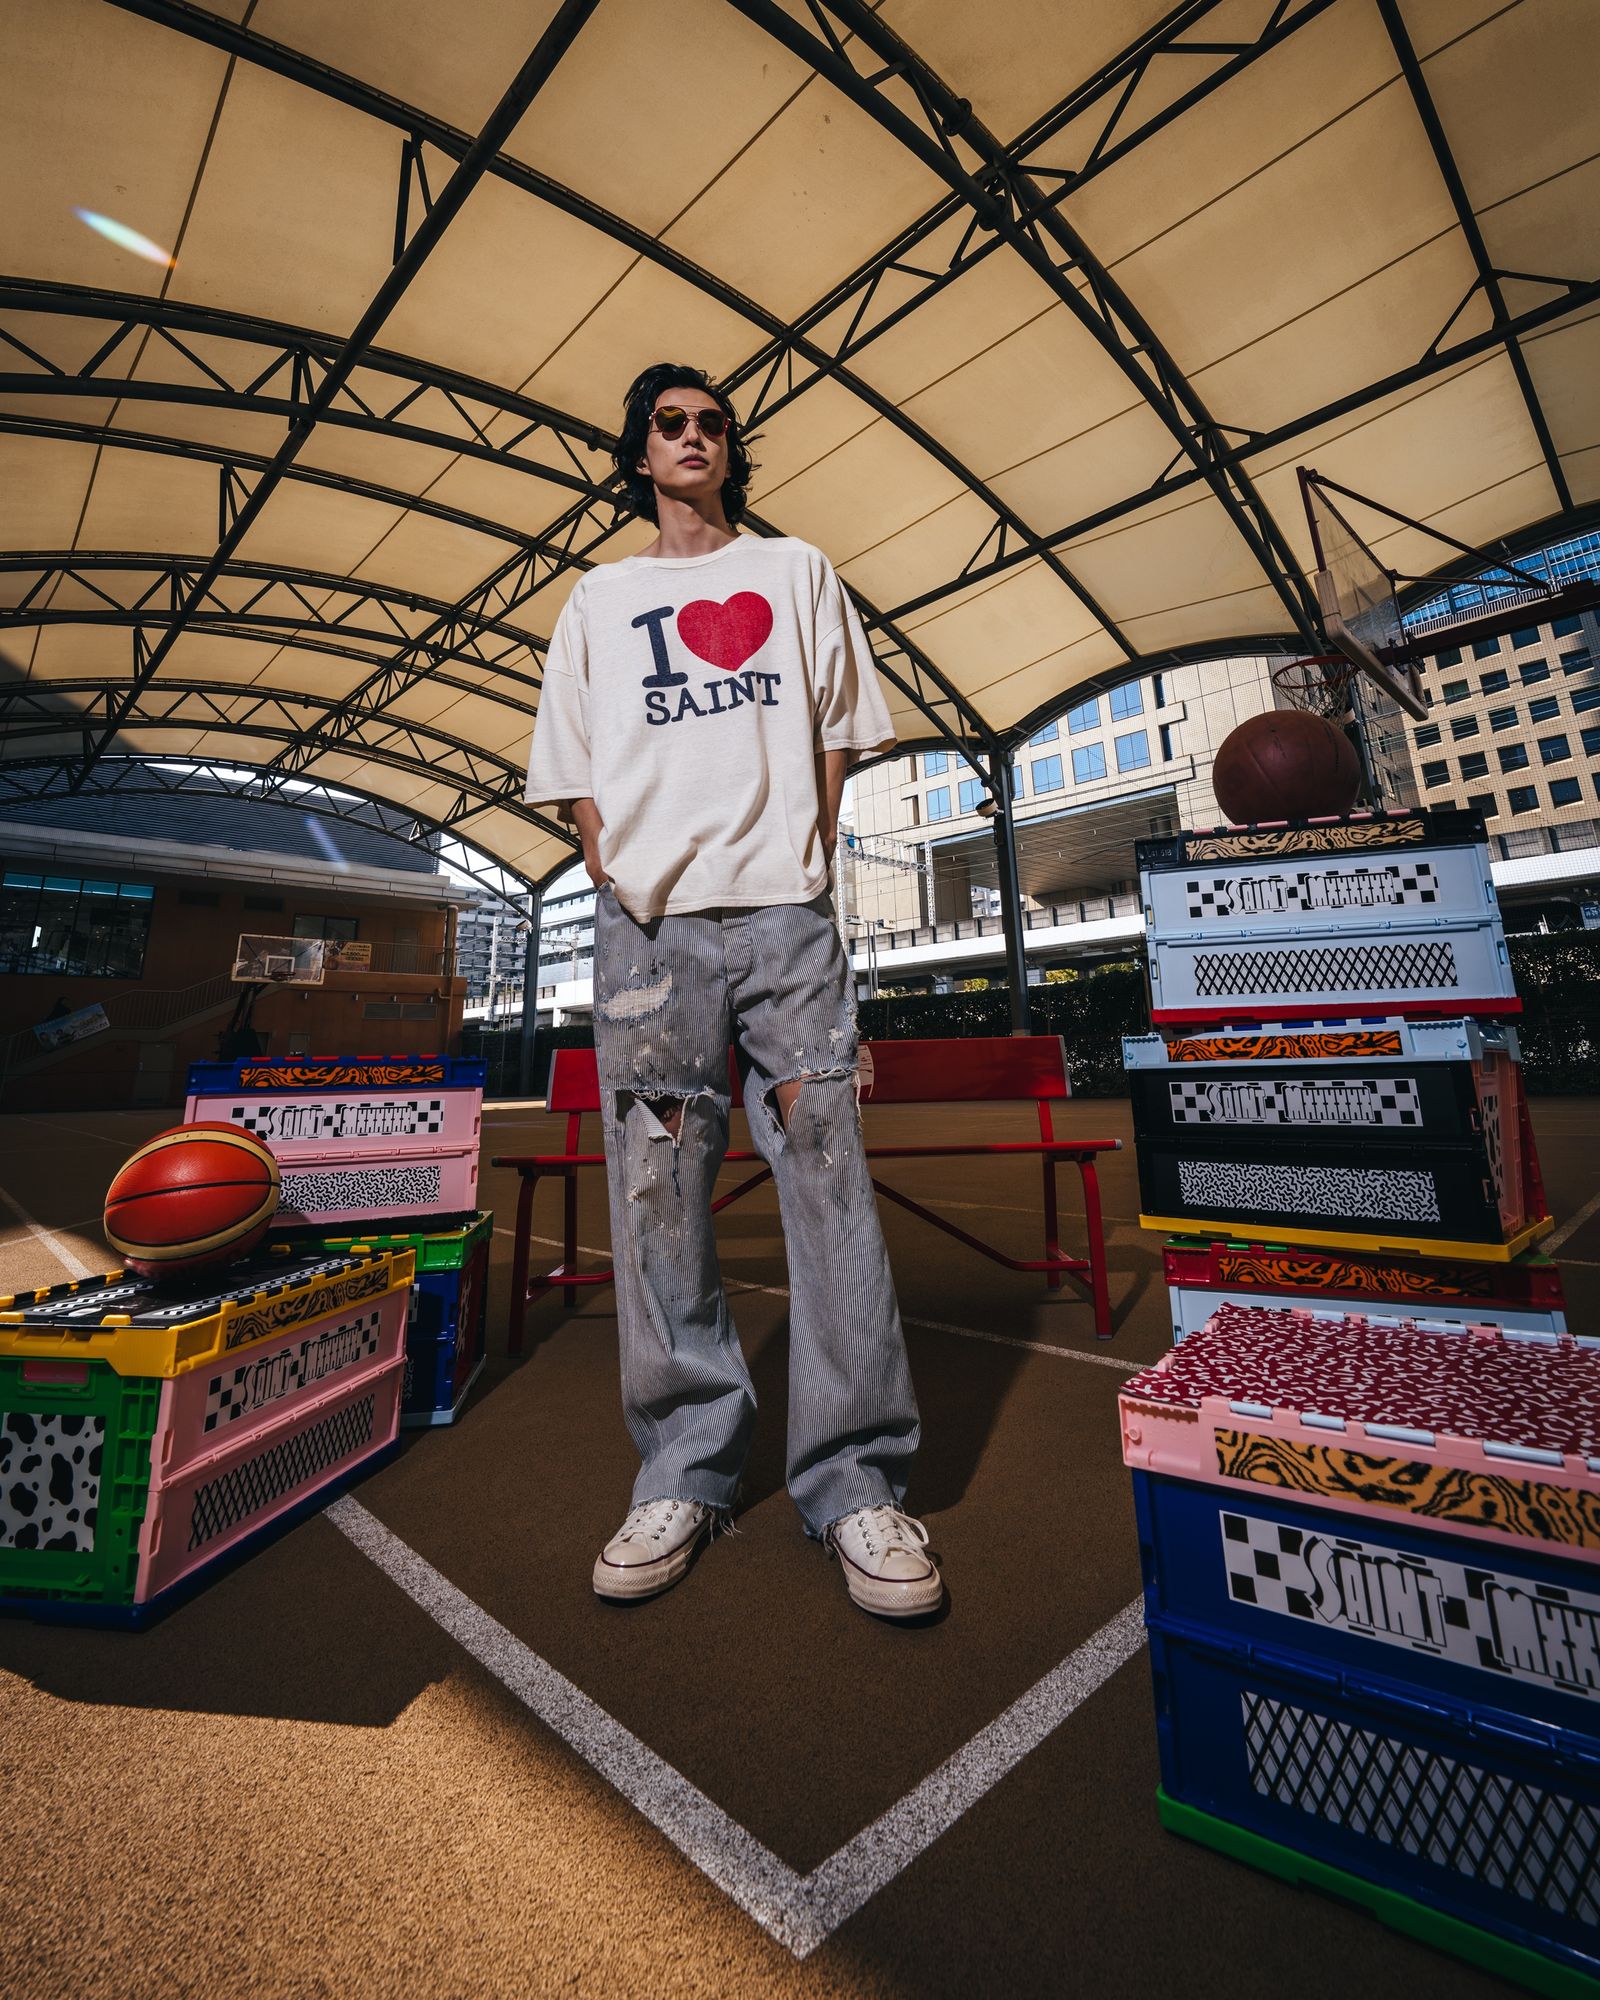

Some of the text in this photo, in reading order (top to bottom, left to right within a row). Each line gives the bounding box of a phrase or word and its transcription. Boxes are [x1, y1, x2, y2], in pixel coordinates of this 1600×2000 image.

[631, 606, 688, 688] I
[645, 671, 781, 725] SAINT
[1224, 878, 1289, 914] SAINT
[266, 1107, 326, 1140] SAINT
[1206, 1083, 1268, 1121] SAINT
[241, 1354, 293, 1412] SAINT
[1303, 1536, 1447, 1647] SAINT
